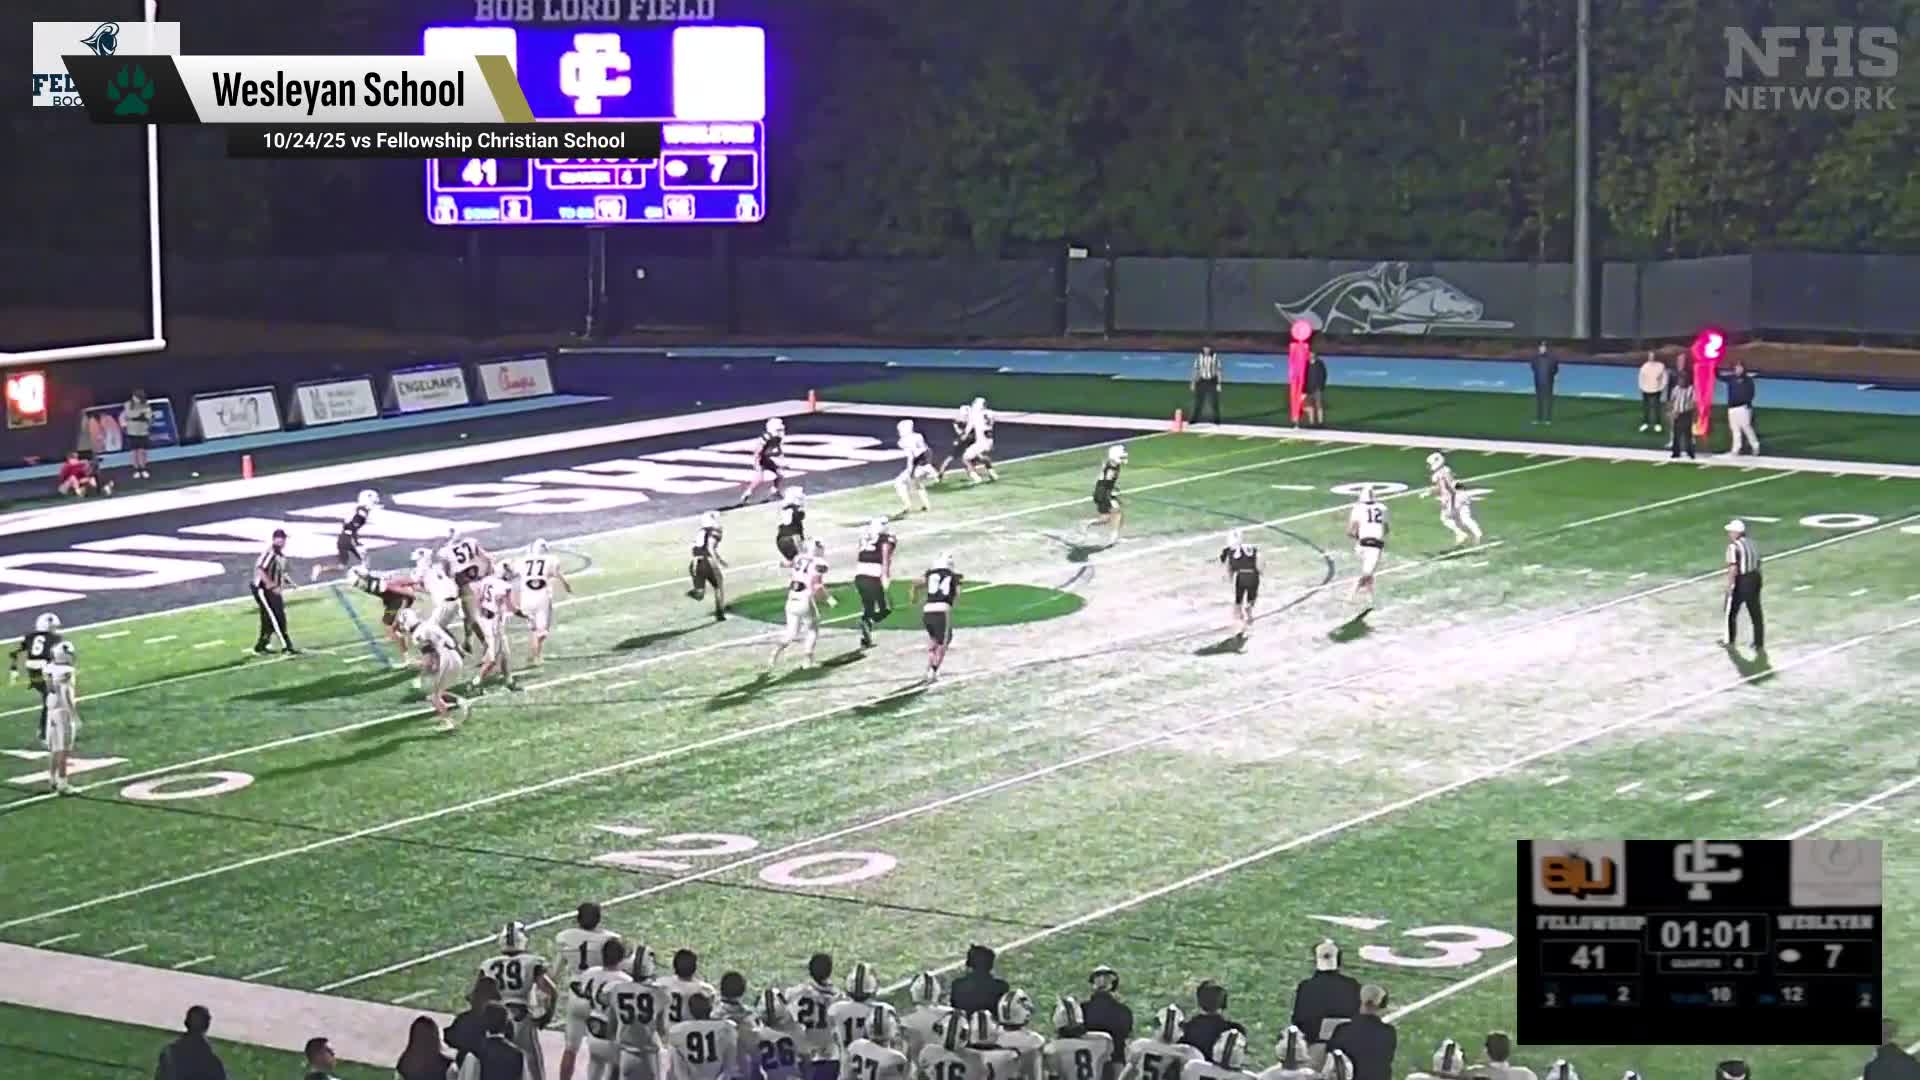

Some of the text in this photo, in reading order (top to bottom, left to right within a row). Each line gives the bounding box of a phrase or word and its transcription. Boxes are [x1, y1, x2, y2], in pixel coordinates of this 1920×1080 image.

[475, 0, 714, 21] BOB LORD FIELD
[462, 158, 497, 186] 41
[707, 154, 728, 183] 7
[1367, 508, 1384, 524] 12
[525, 559, 546, 576] 77
[32, 634, 46, 657] 6
[588, 832, 898, 886] 20
[579, 941, 589, 970] 1
[1358, 925, 1514, 968] 3
[617, 992, 655, 1024] 59
[798, 996, 827, 1029] 21
[686, 1031, 718, 1064] 91
[1075, 1048, 1093, 1080] 8
